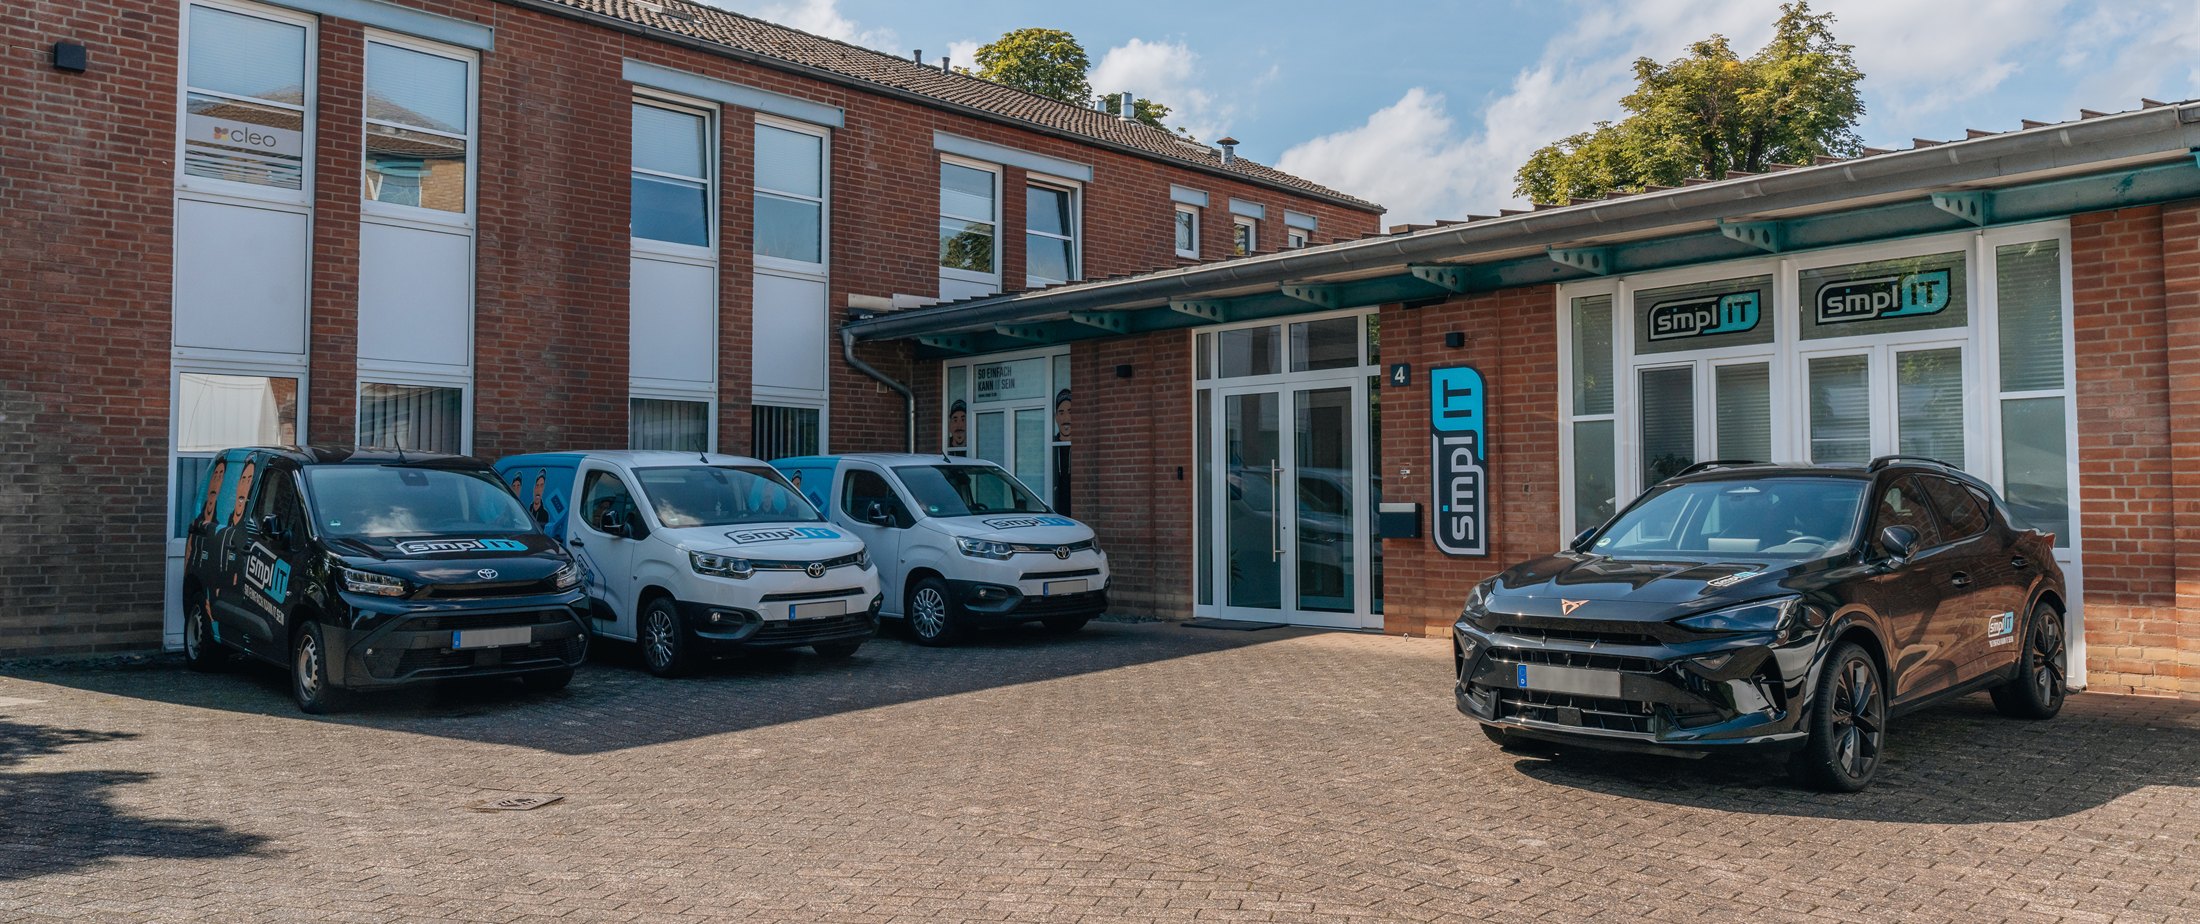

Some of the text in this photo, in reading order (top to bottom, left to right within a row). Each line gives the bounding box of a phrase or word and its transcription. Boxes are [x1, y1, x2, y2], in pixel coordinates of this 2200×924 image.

[230, 126, 277, 148] cleo
[977, 365, 1012, 379] SO EINFACH
[1394, 366, 1405, 383] 4
[977, 380, 993, 391] KANN
[1001, 378, 1016, 389] SEIN
